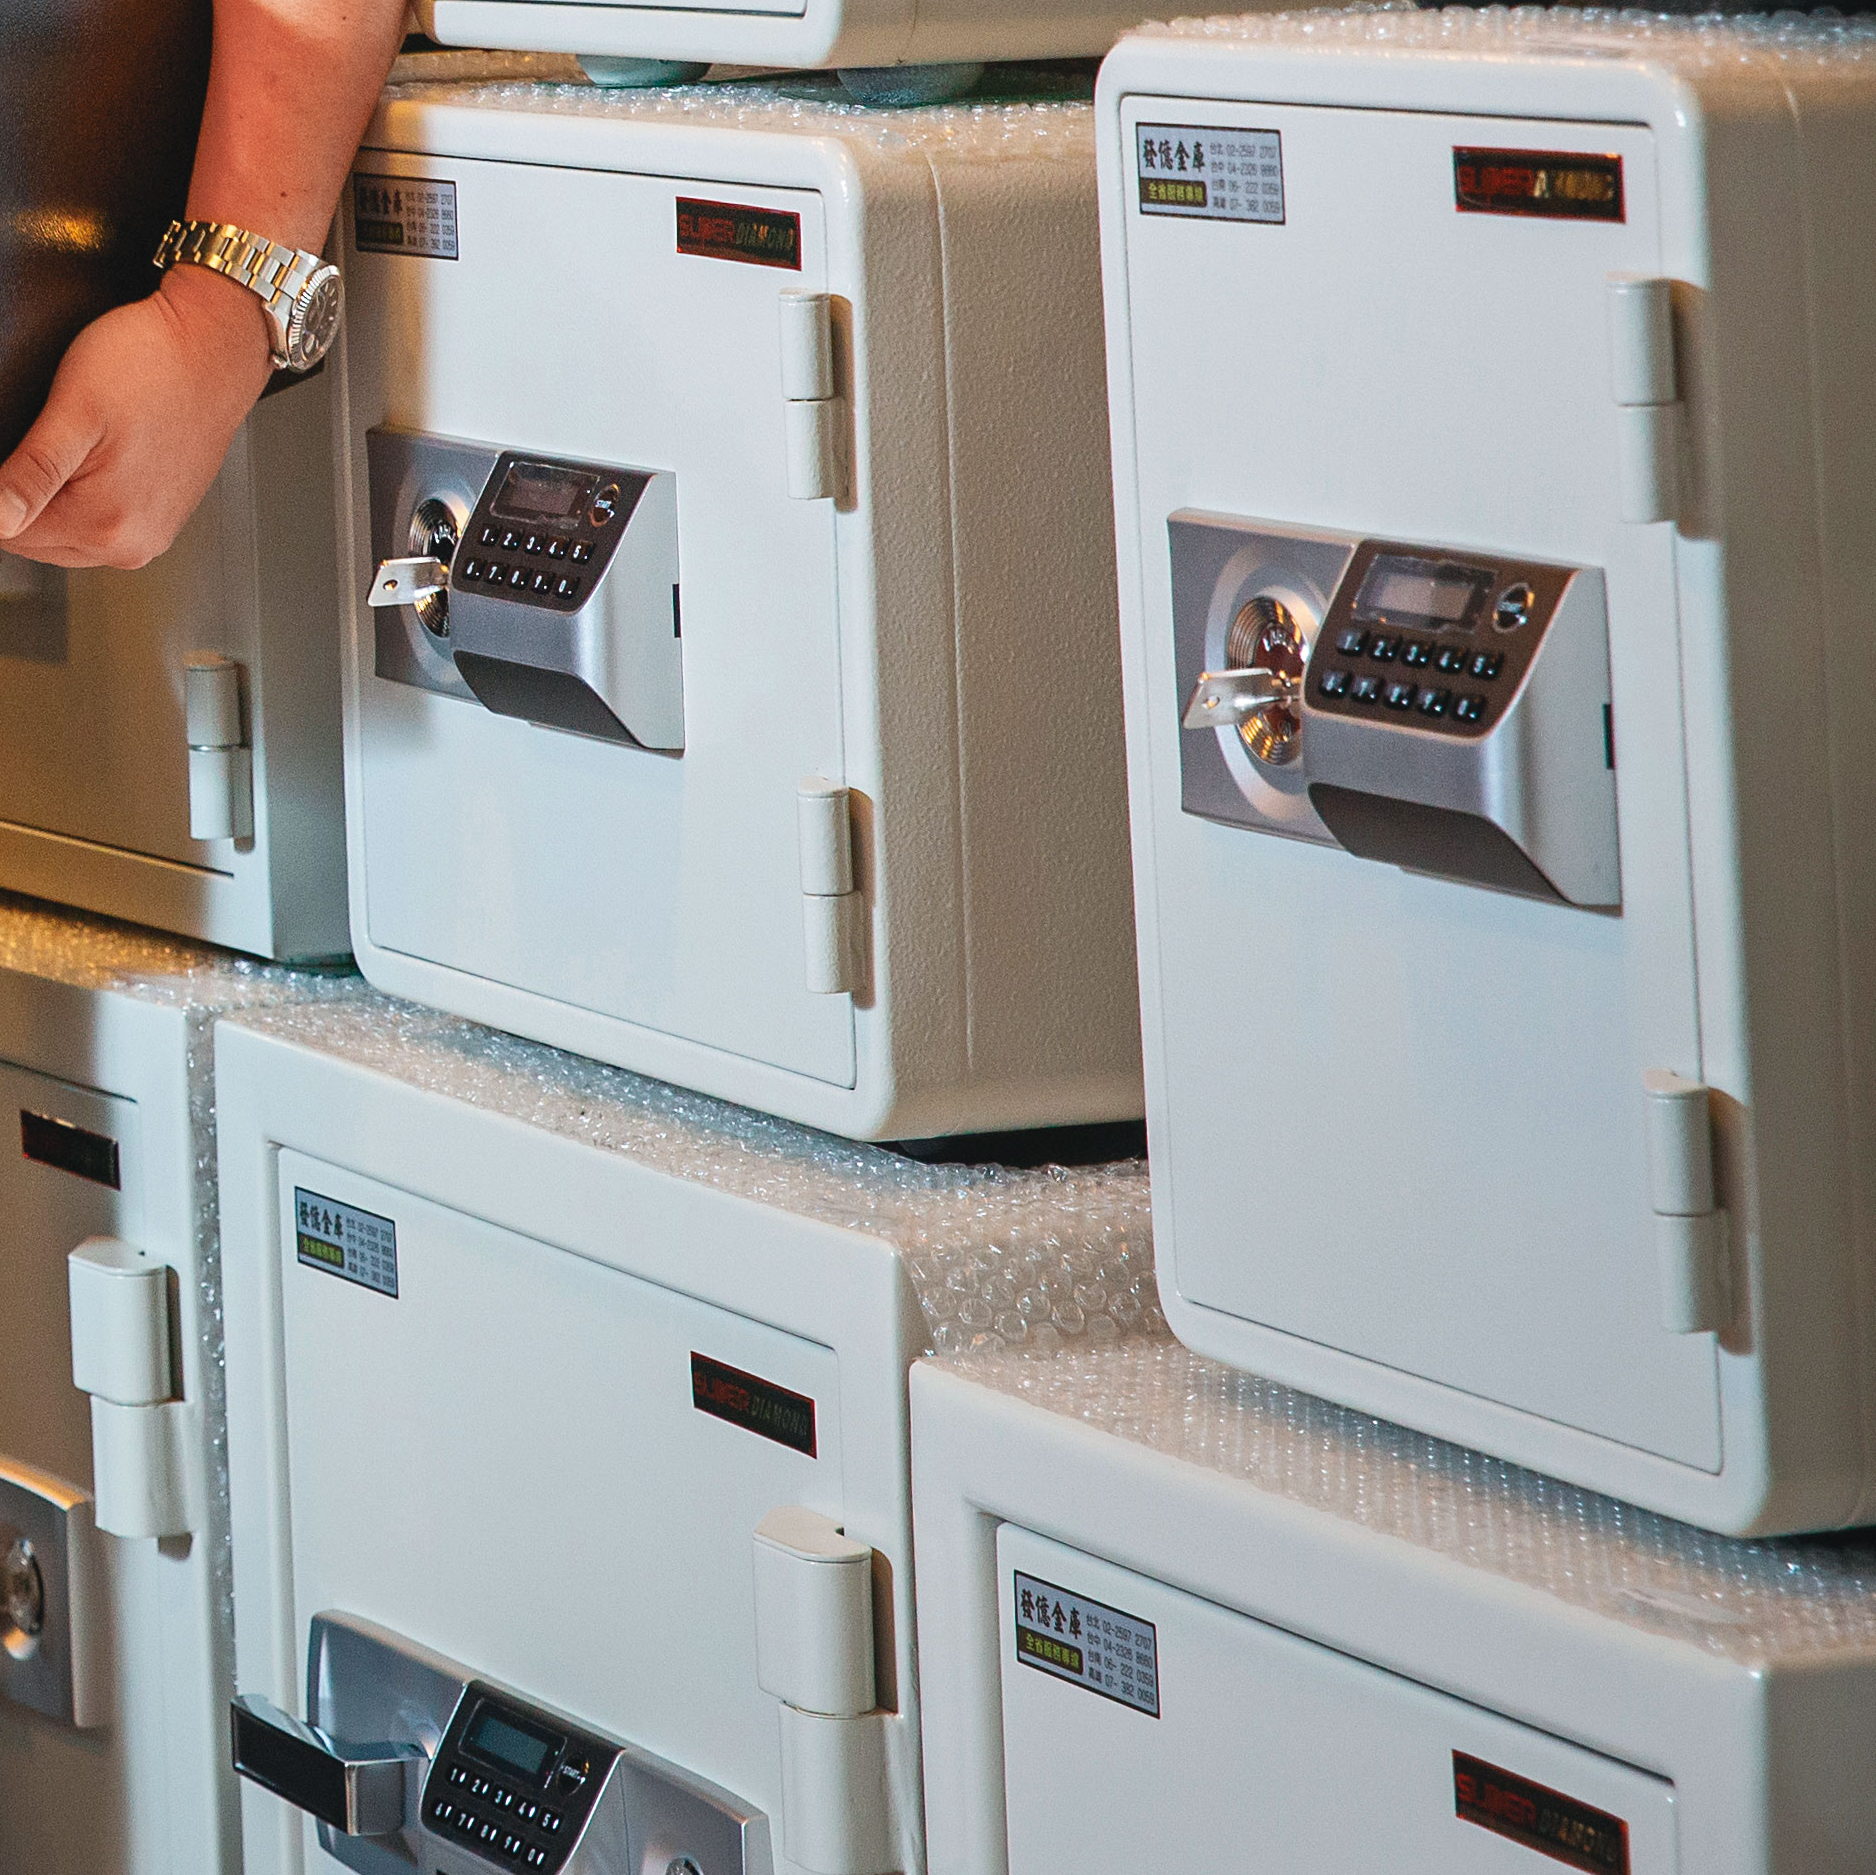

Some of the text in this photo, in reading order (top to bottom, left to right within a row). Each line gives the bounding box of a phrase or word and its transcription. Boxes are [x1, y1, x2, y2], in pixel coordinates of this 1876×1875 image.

[1143, 139, 1205, 172] 發億金庫
[1021, 1588, 1082, 1640] 發億金庫
